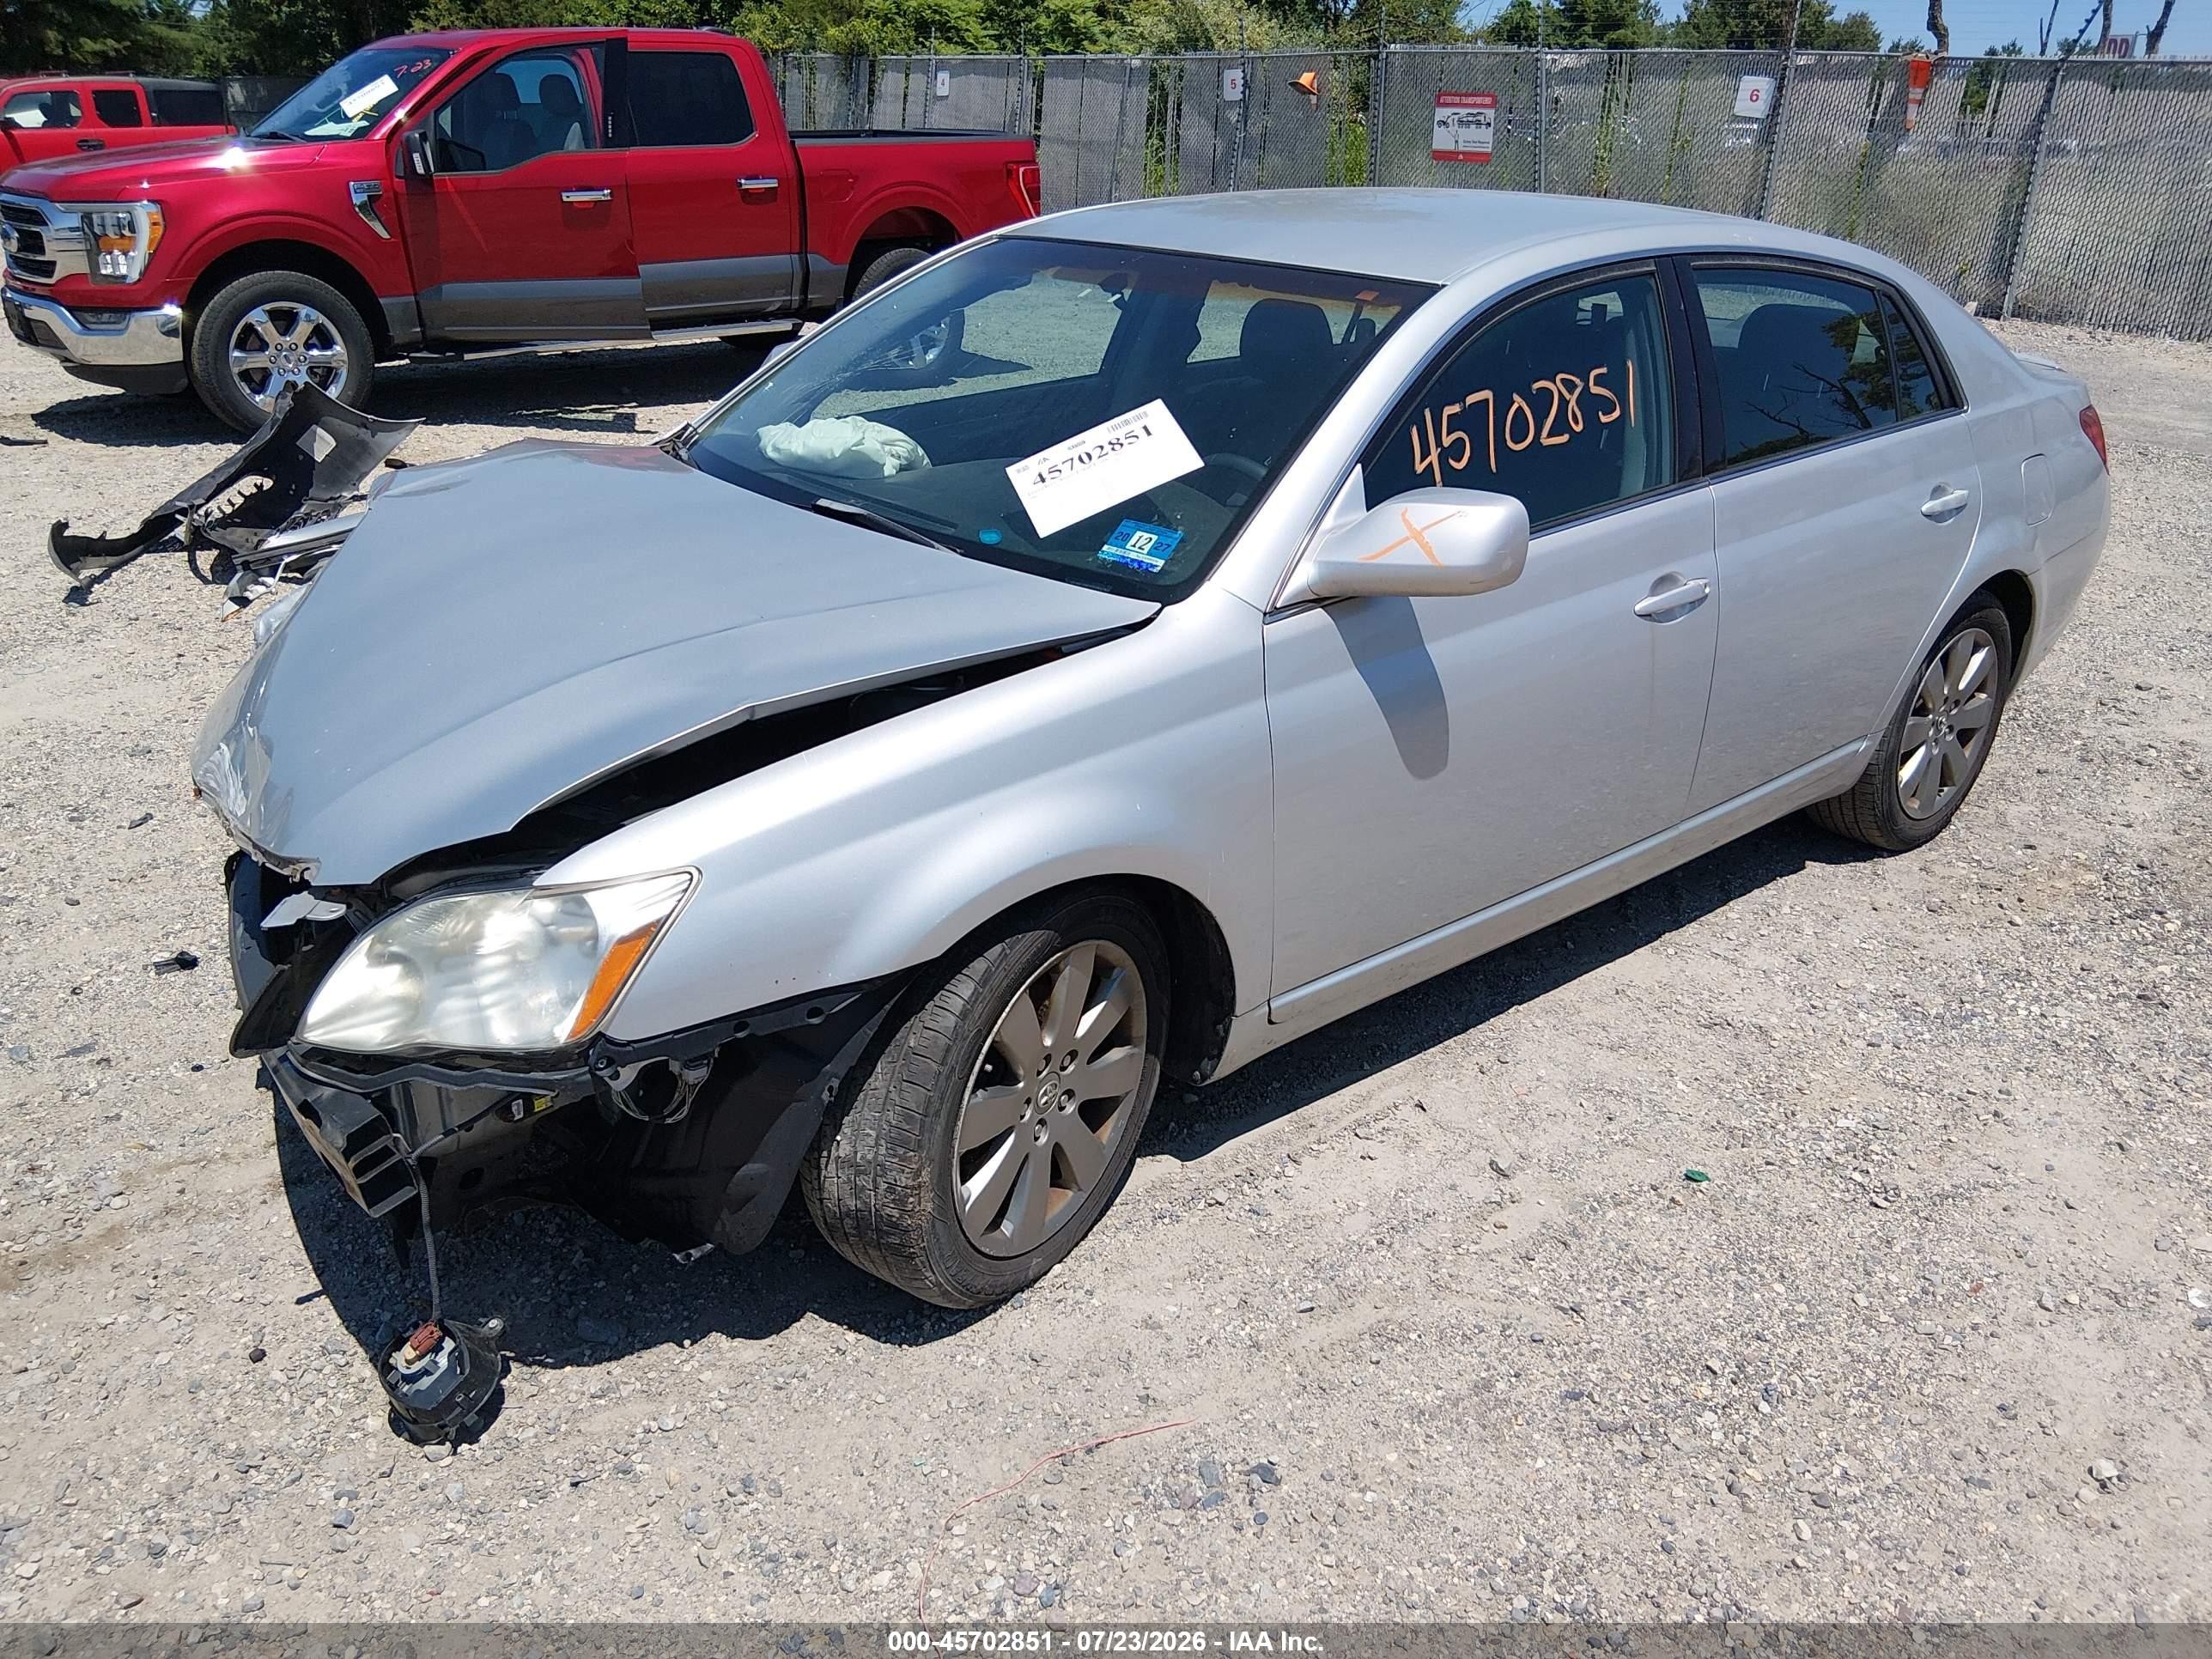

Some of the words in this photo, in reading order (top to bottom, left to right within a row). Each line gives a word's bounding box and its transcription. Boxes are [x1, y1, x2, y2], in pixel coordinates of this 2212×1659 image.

[940, 78, 945, 88] 4
[1230, 78, 1237, 90] 5
[1749, 88, 1760, 103] 6
[1410, 360, 1634, 488] 45702851
[1033, 425, 1153, 486] 45702851
[1114, 531, 1131, 542] 20
[1130, 534, 1153, 551] 12
[1153, 542, 1172, 552] 27
